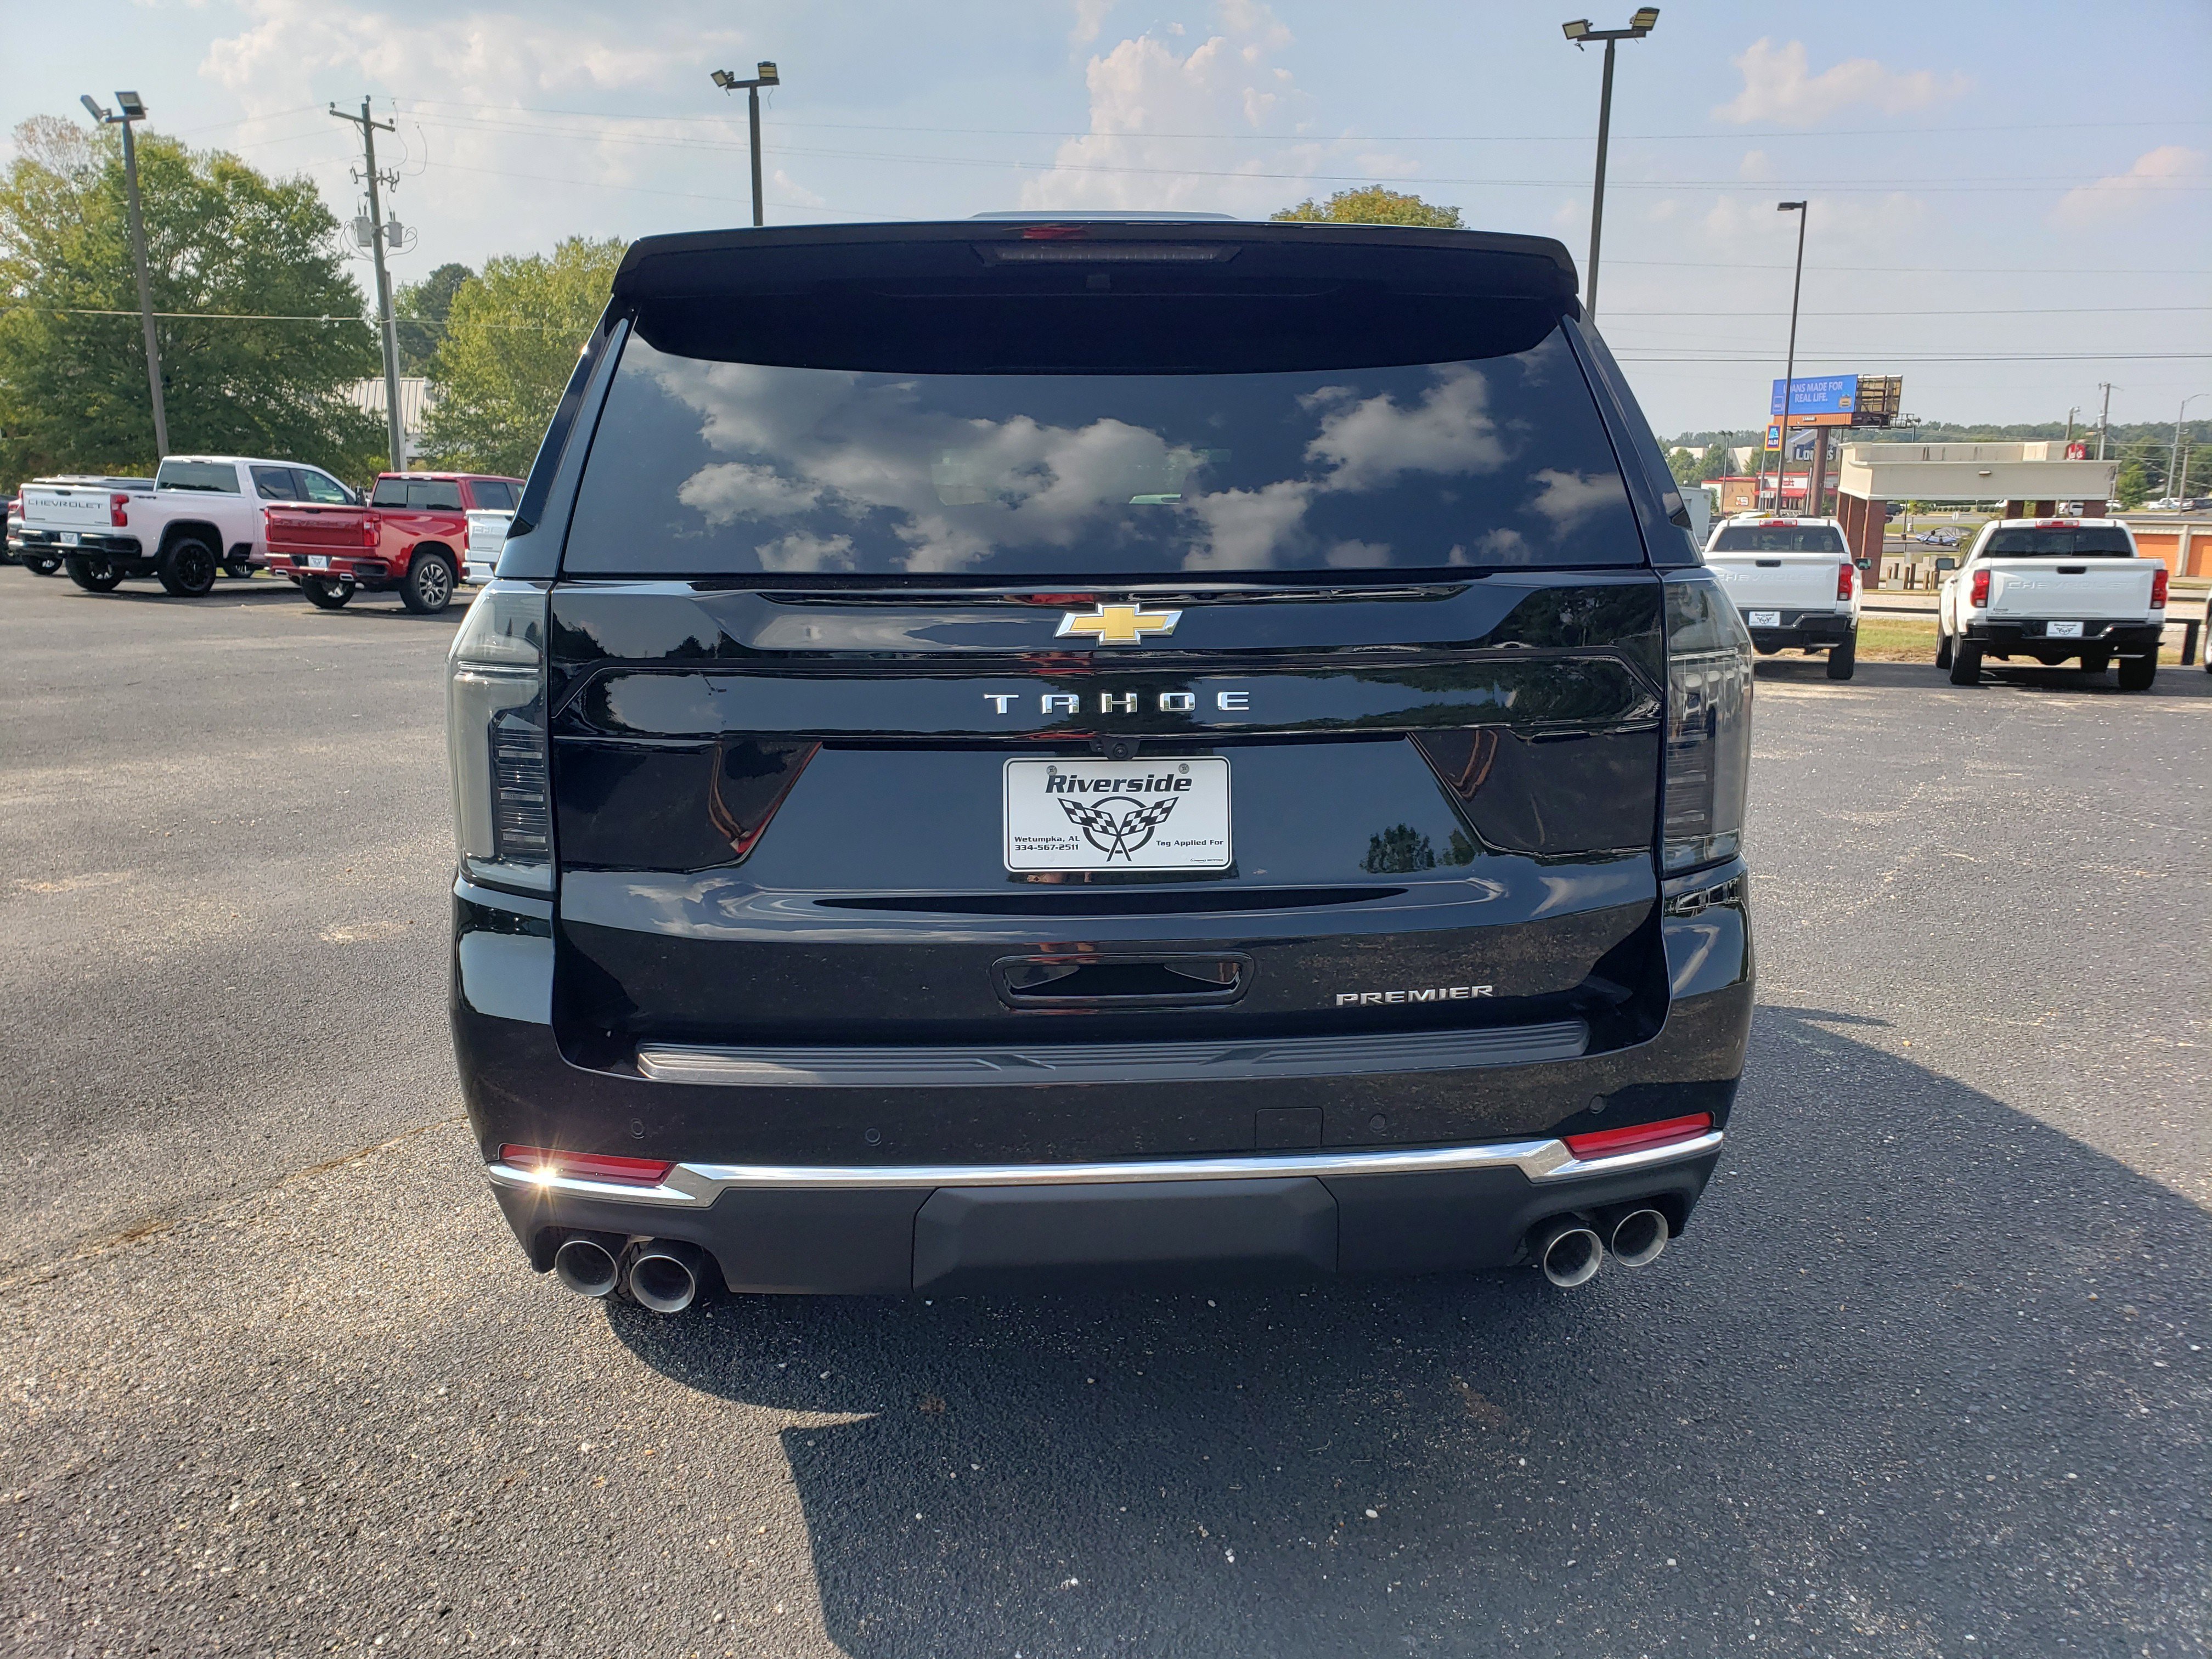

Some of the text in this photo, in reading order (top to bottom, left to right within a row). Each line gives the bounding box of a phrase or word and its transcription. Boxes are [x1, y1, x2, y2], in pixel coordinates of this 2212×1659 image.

[1784, 381, 1843, 393] LANS MADE FOR
[1795, 392, 1828, 403] REAL LIFE.
[28, 499, 103, 509] CHEVROLET
[984, 691, 1249, 714] TAHOE
[1045, 774, 1193, 793] Riverside
[1336, 985, 1493, 1006] PREMIER
